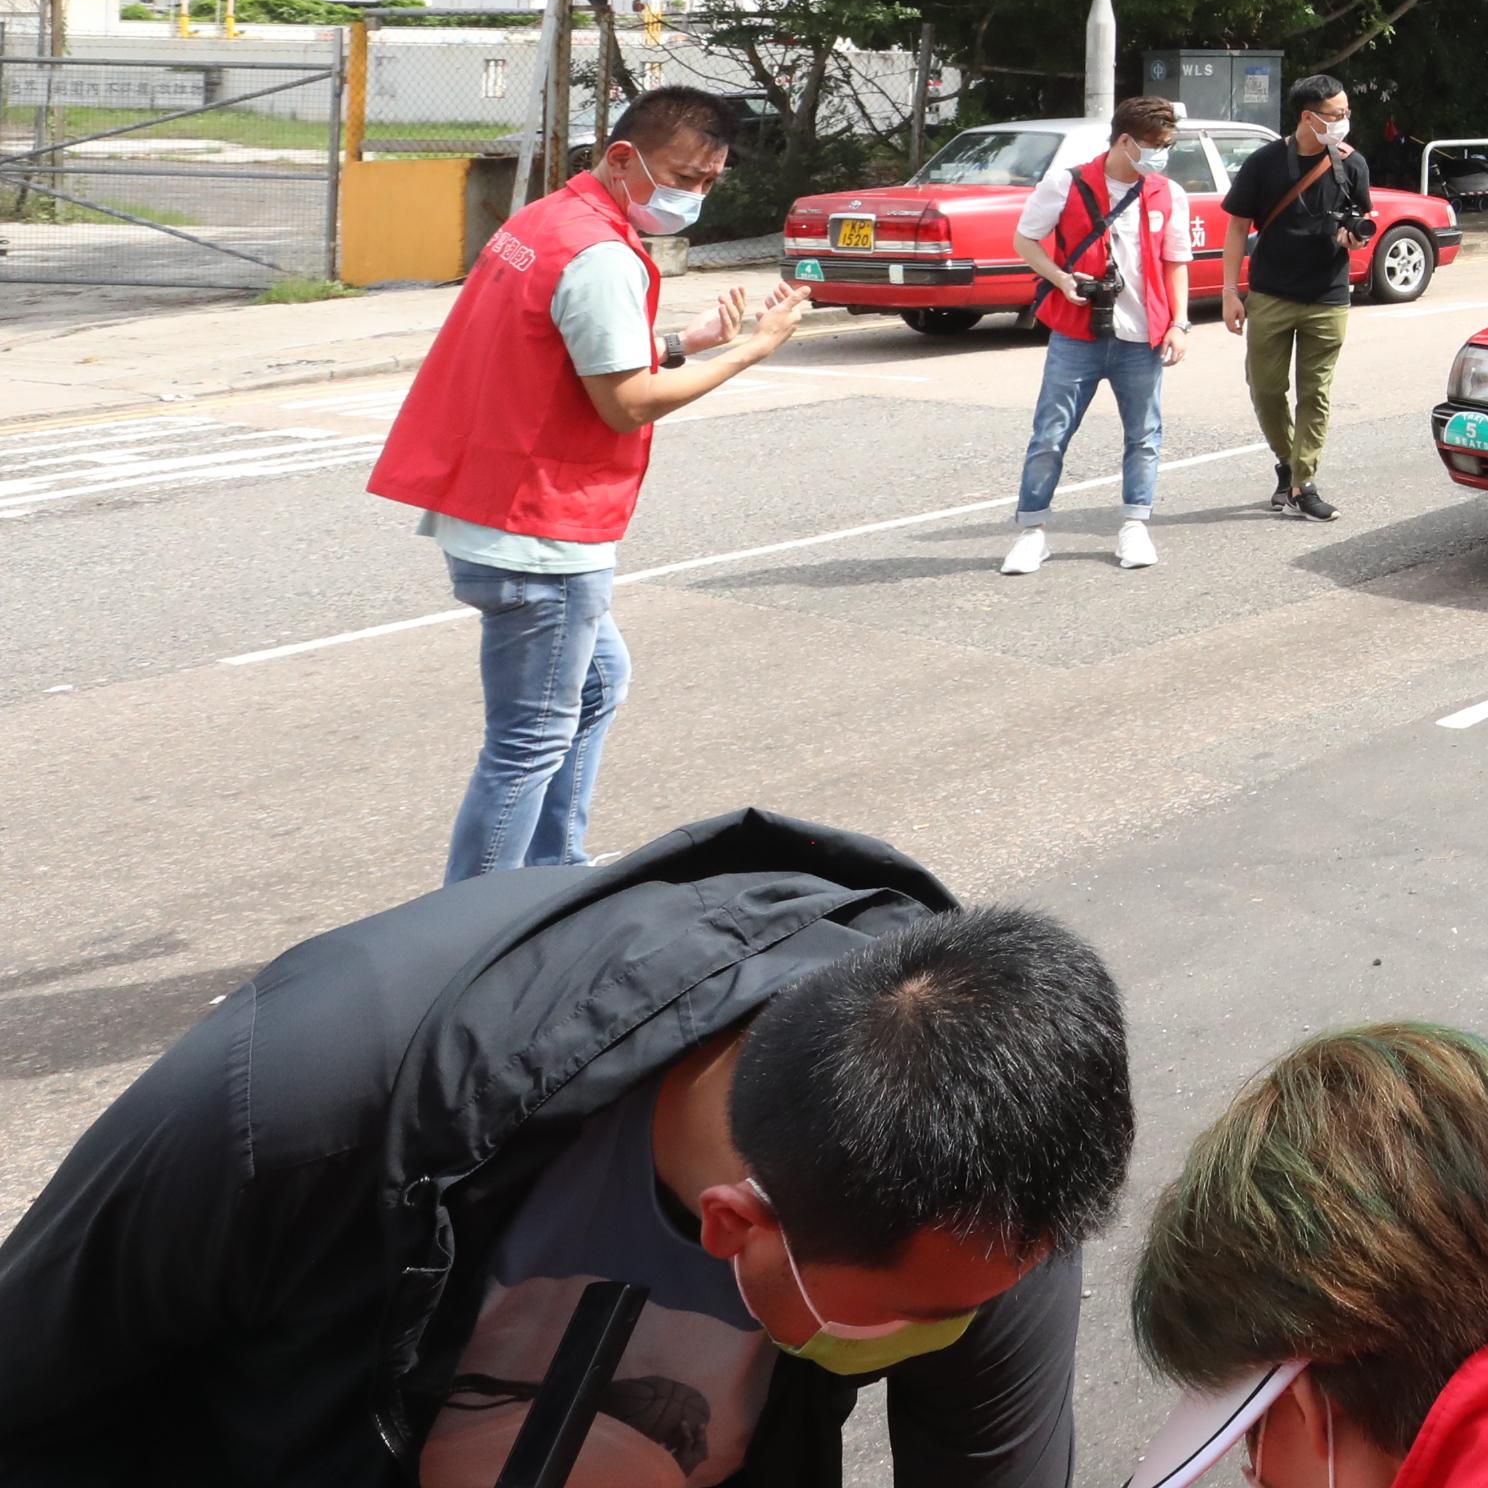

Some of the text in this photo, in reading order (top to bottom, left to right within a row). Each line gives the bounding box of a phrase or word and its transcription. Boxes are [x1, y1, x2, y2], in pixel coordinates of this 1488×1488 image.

[1182, 64, 1214, 76] WLS
[850, 220, 866, 231] KP
[1190, 216, 1205, 231] 士
[841, 233, 869, 246] 1520
[1191, 231, 1206, 247] XI
[805, 265, 812, 273] 4
[1462, 414, 1484, 423] TAXI
[1466, 424, 1477, 438] 5
